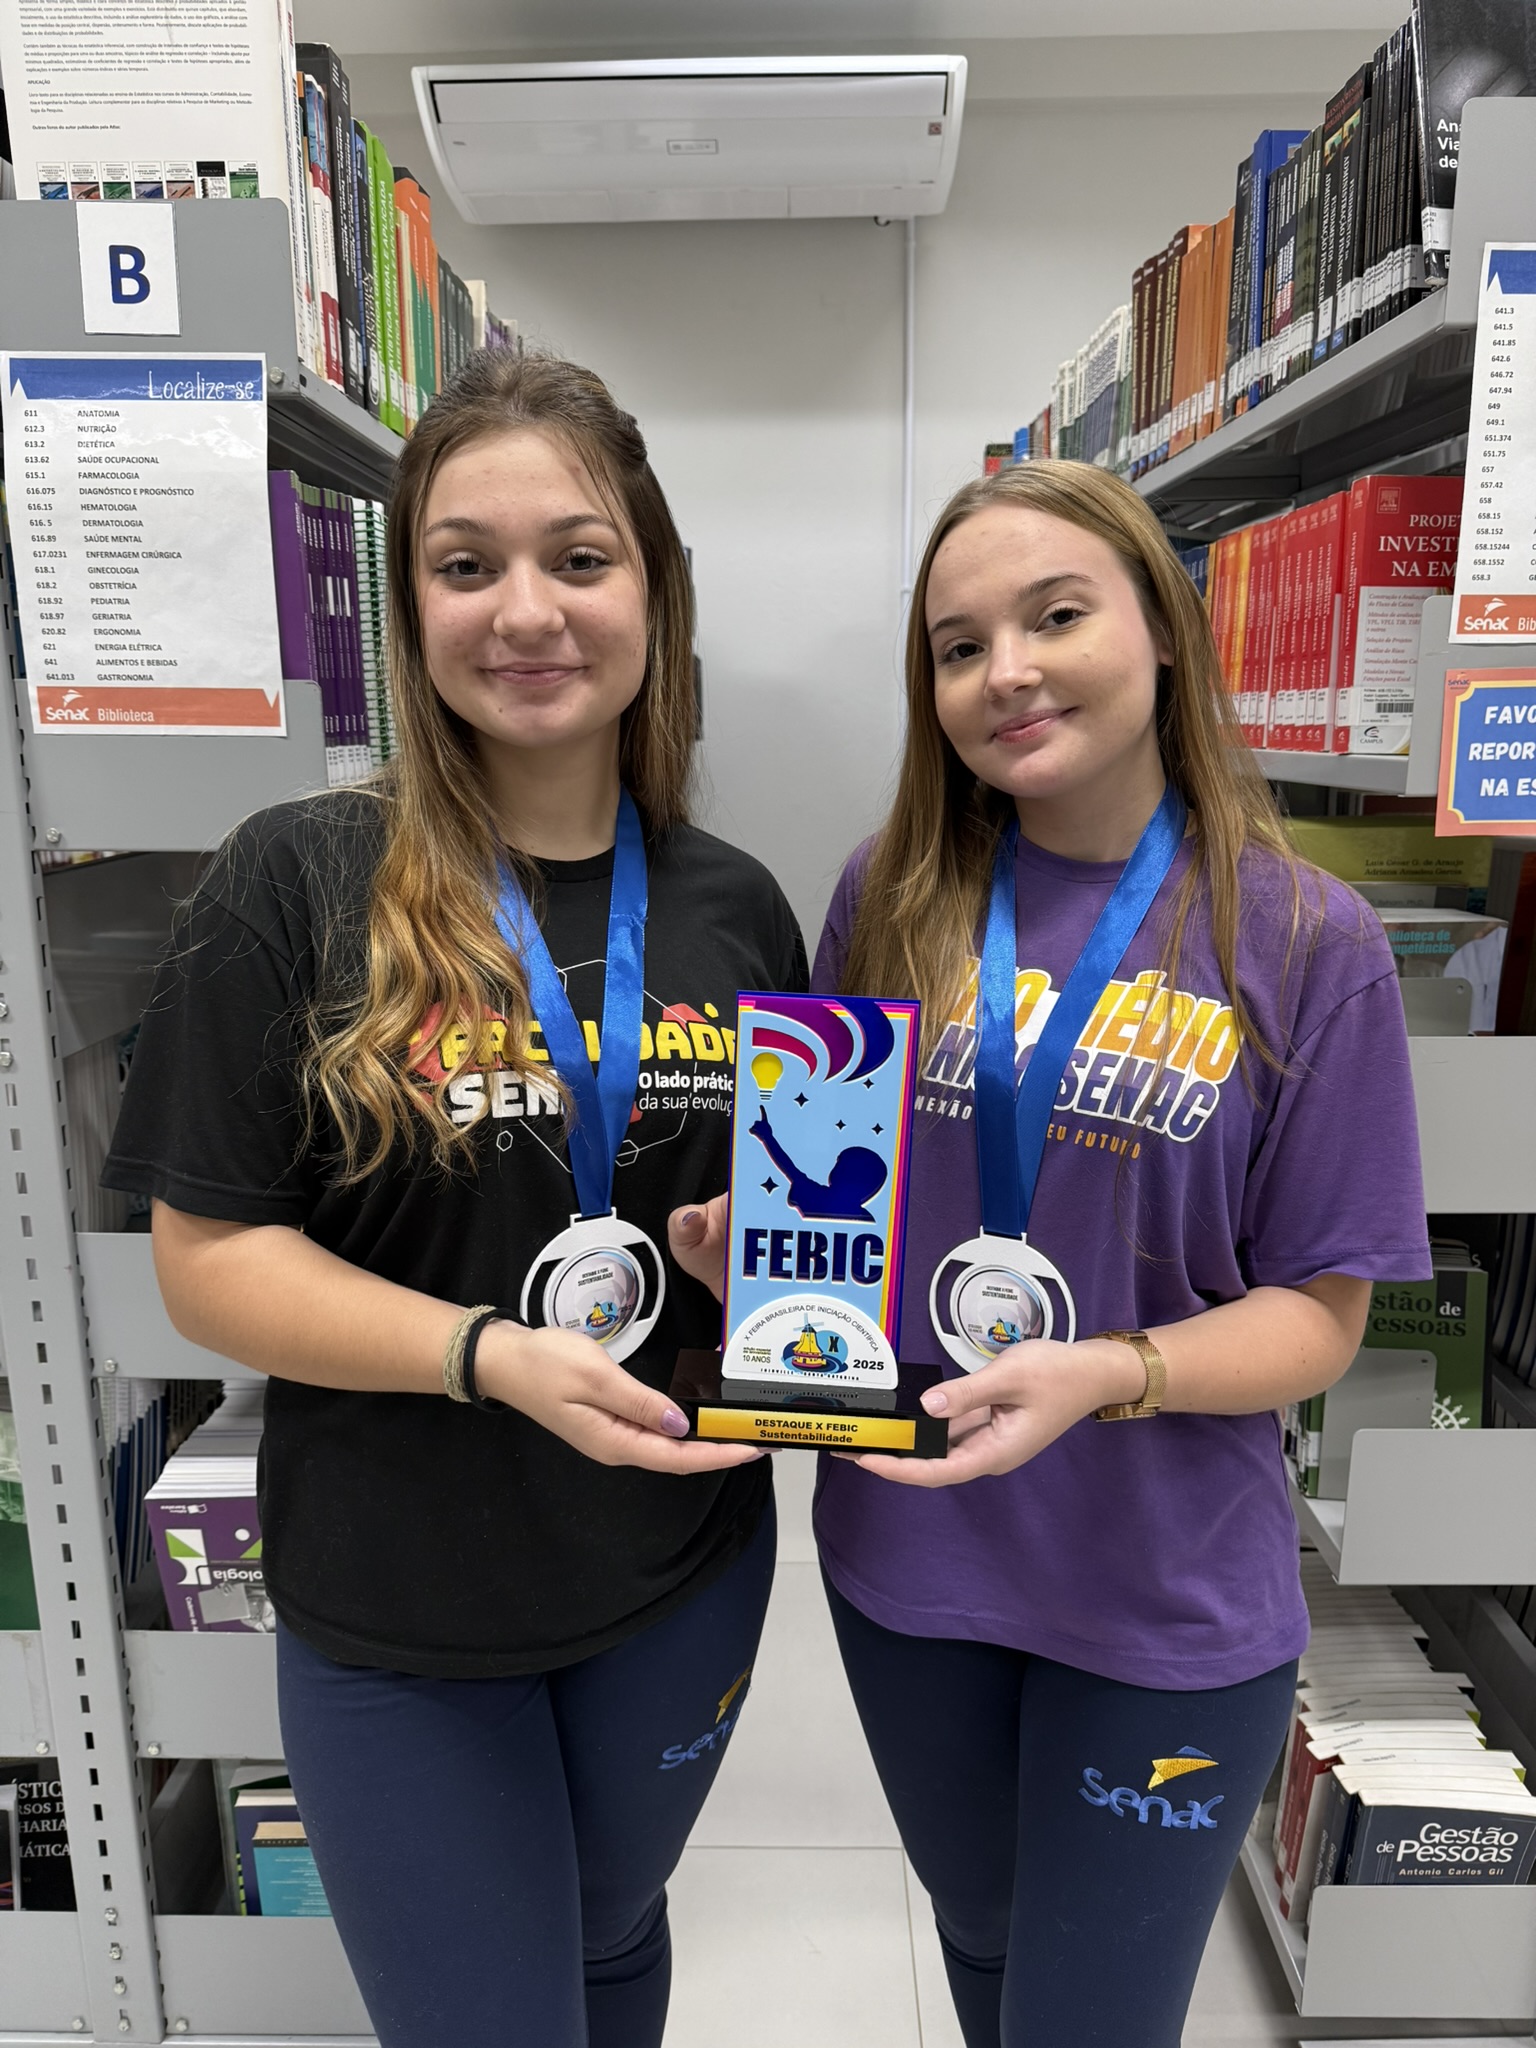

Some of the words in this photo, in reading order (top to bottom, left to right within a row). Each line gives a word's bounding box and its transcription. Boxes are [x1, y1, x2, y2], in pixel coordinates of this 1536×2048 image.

[108, 245, 150, 305] B
[1494, 307, 1515, 315] 641.3
[1493, 323, 1514, 331] 641.5
[1492, 339, 1517, 347] 641.85
[1491, 354, 1511, 363] 642.6
[1489, 370, 1514, 379] 646.72
[147, 370, 255, 401] Localize-se
[1488, 386, 1513, 395] 647.94
[1487, 402, 1501, 410] 649
[23, 409, 38, 417] 611
[77, 409, 120, 418] ANATOMIA
[1485, 418, 1505, 426] 649.1
[24, 425, 45, 433] 612.3
[77, 423, 117, 434] NUTRIÇÃO
[1484, 434, 1512, 442] 651.374
[24, 440, 45, 448] 613.2
[1482, 450, 1506, 458] 651.75
[24, 455, 50, 464] 613.62
[77, 454, 103, 464] SAÚDE
[104, 456, 160, 464] OCUPACIONAL
[1481, 465, 1495, 474] 657
[25, 471, 46, 479] 615.1
[77, 471, 140, 480] FARMACOLOGIA
[1480, 481, 1504, 489] 657.42
[26, 487, 56, 495] 616.075
[78, 486, 132, 496] DIAGNÓSTICO
[132, 488, 138, 496] E
[139, 487, 195, 496] PROGNÓSTICO
[1478, 497, 1492, 505] 658
[27, 503, 53, 511] 616.15
[80, 503, 138, 512] HEMATOLOGIA
[1477, 512, 1501, 520] 658.15
[82, 519, 144, 528] DERMATOLOGIA
[1475, 527, 1504, 535] 658.152
[31, 534, 57, 543] 616.89
[83, 533, 109, 543] SAÚDE
[110, 535, 143, 543] MENTAL
[1474, 543, 1511, 551] 658.15244
[32, 550, 68, 559] 617.0231
[85, 550, 140, 559] ENFERMAGEM
[141, 550, 183, 559] CIRÚRGICA
[1473, 558, 1505, 566] 658.1552
[34, 566, 56, 574] 618.1
[87, 566, 140, 575] GINECOLOGIA
[1390, 561, 1422, 577] NA
[1471, 573, 1491, 581] 658.3
[36, 581, 57, 590] 618.2
[88, 581, 138, 590] OBSTETRÍCIA
[37, 597, 63, 605] 618.92
[90, 597, 131, 605] PEDIATRIA
[39, 612, 65, 620] 618.97
[91, 612, 132, 621] GERIATRIA
[41, 627, 66, 636] 620.82
[93, 628, 142, 636] ERGONOMIA
[42, 643, 57, 651] 621
[94, 643, 128, 651] ENERGIA
[128, 643, 163, 652] ELÉTRICA
[44, 658, 58, 666] 641
[95, 658, 140, 667] ALIMENTOS
[140, 659, 145, 667] E
[146, 659, 178, 667] BEBIDAS
[45, 673, 75, 681] 641.013
[96, 673, 154, 682] GASTRONOMIA
[97, 708, 155, 723] Biblioteca
[1480, 778, 1509, 797] NA
[638, 1072, 652, 1089] O
[655, 1072, 691, 1089] lado
[639, 1095, 658, 1110] da
[662, 1095, 690, 1109] sua
[742, 1227, 885, 1288] FEBIC
[1439, 1302, 1462, 1317] de
[749, 1319, 767, 1337] FEIRA
[765, 1305, 806, 1323] BRASILEIRA
[806, 1304, 816, 1312] DE
[817, 1306, 852, 1324] INICIAÇÃO
[851, 1321, 879, 1353] CIENTÍFICA
[1371, 1316, 1466, 1338] essoas
[750, 1355, 771, 1364] ANOS
[852, 1359, 885, 1371] 2025
[754, 1418, 813, 1430] DESTAQUE
[816, 1422, 823, 1430] X
[826, 1422, 859, 1433] FEBIC
[759, 1429, 853, 1444] Sustentabilidade
[212, 1568, 263, 1582] ologia
[1419, 1822, 1519, 1847] Gestão
[1376, 1840, 1395, 1854] de
[1396, 1839, 1514, 1863] Pessoas
[1399, 1867, 1442, 1876] Antonio
[1448, 1867, 1482, 1876] Carlos
[1488, 1868, 1505, 1876] Gil
